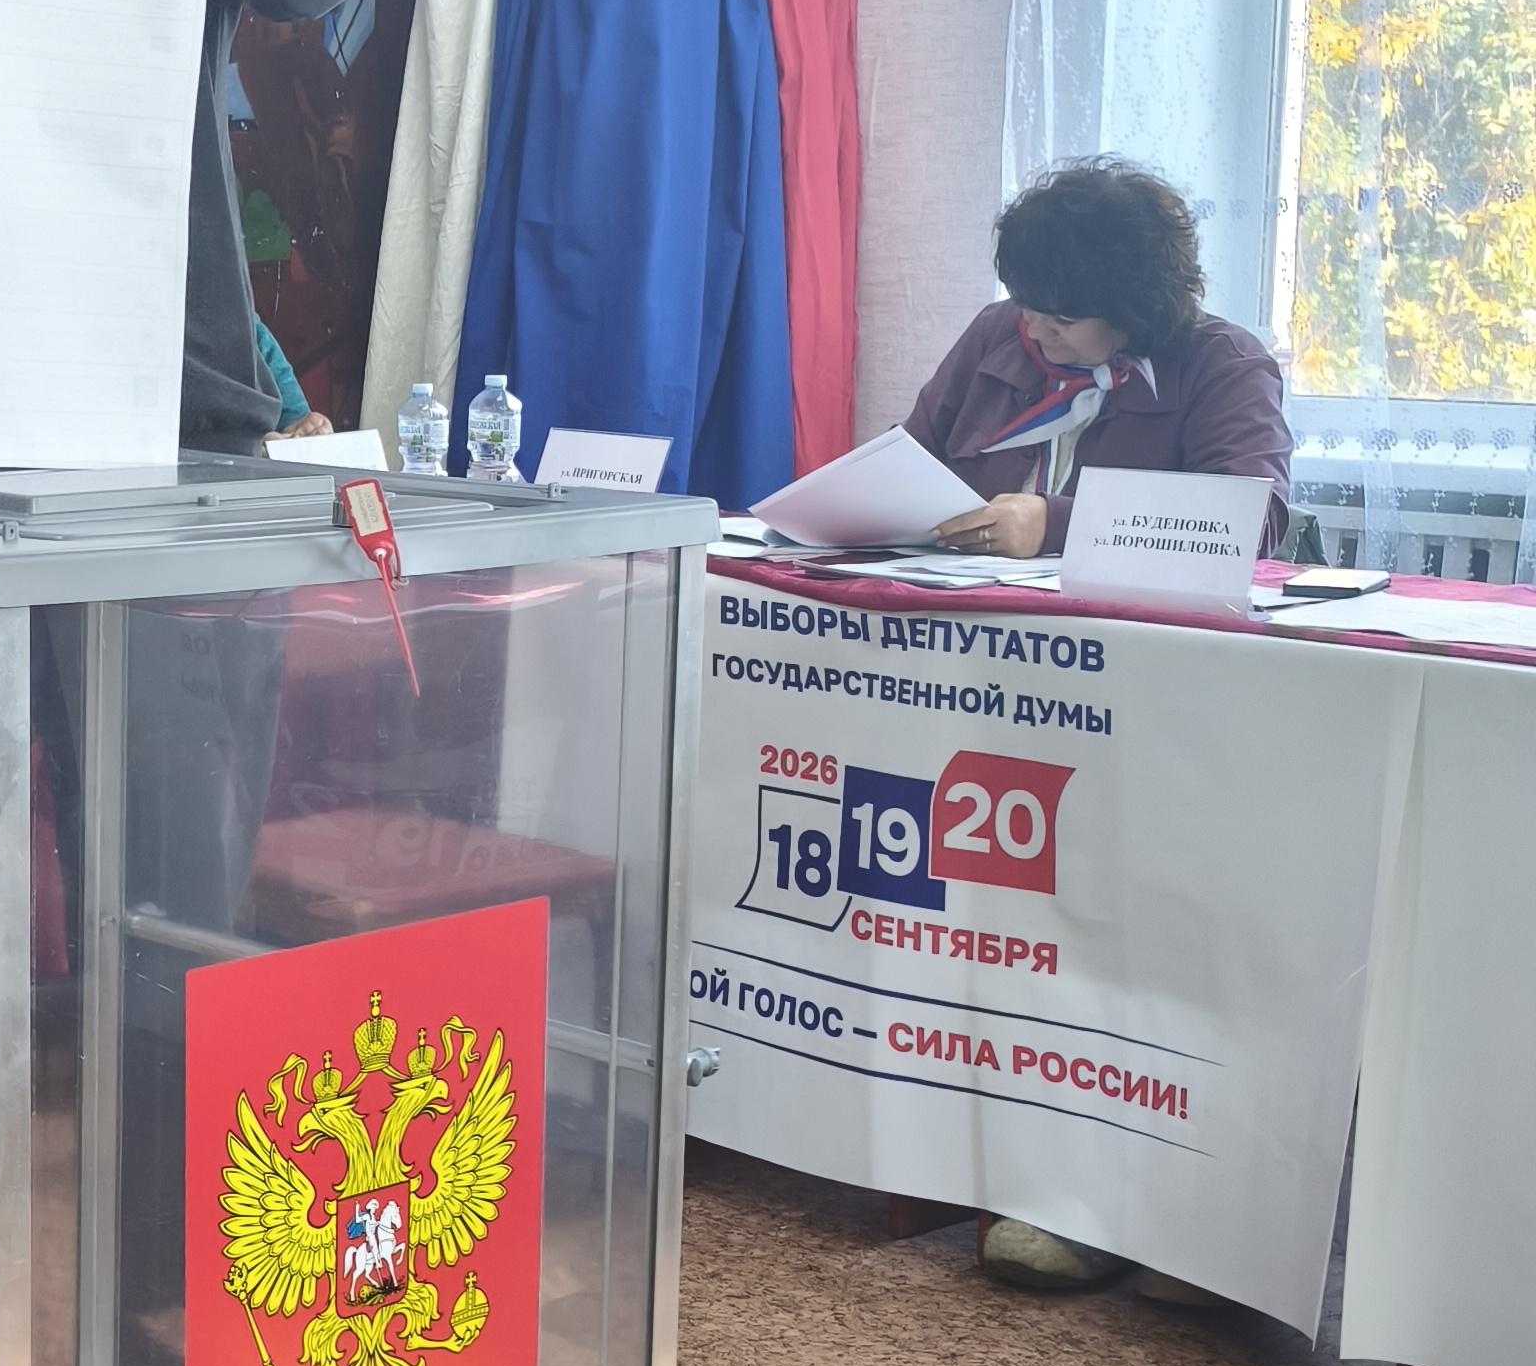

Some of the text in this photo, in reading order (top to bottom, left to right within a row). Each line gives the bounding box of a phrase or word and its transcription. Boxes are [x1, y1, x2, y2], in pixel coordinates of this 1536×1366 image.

[572, 467, 643, 484] ПРИГОРСКАЯ
[1093, 534, 1241, 557] ул. ВОРОШИЛОВКА
[1131, 515, 1230, 535] БУДЕНОВКА
[720, 595, 1105, 672] ВЫБОРЫ ДЕПУТАТОВ
[712, 653, 1112, 735] ГОСУДАРСТВЕННОЙ ДУМЫ
[760, 744, 838, 785] 2026
[768, 781, 1047, 898] 18 19 20
[850, 909, 1058, 975] СЕНТЯБРЯ
[738, 982, 844, 1038] ГОЛОС
[887, 1022, 1001, 1071] СИЛА
[1012, 1044, 1188, 1119] РОССИИ!
